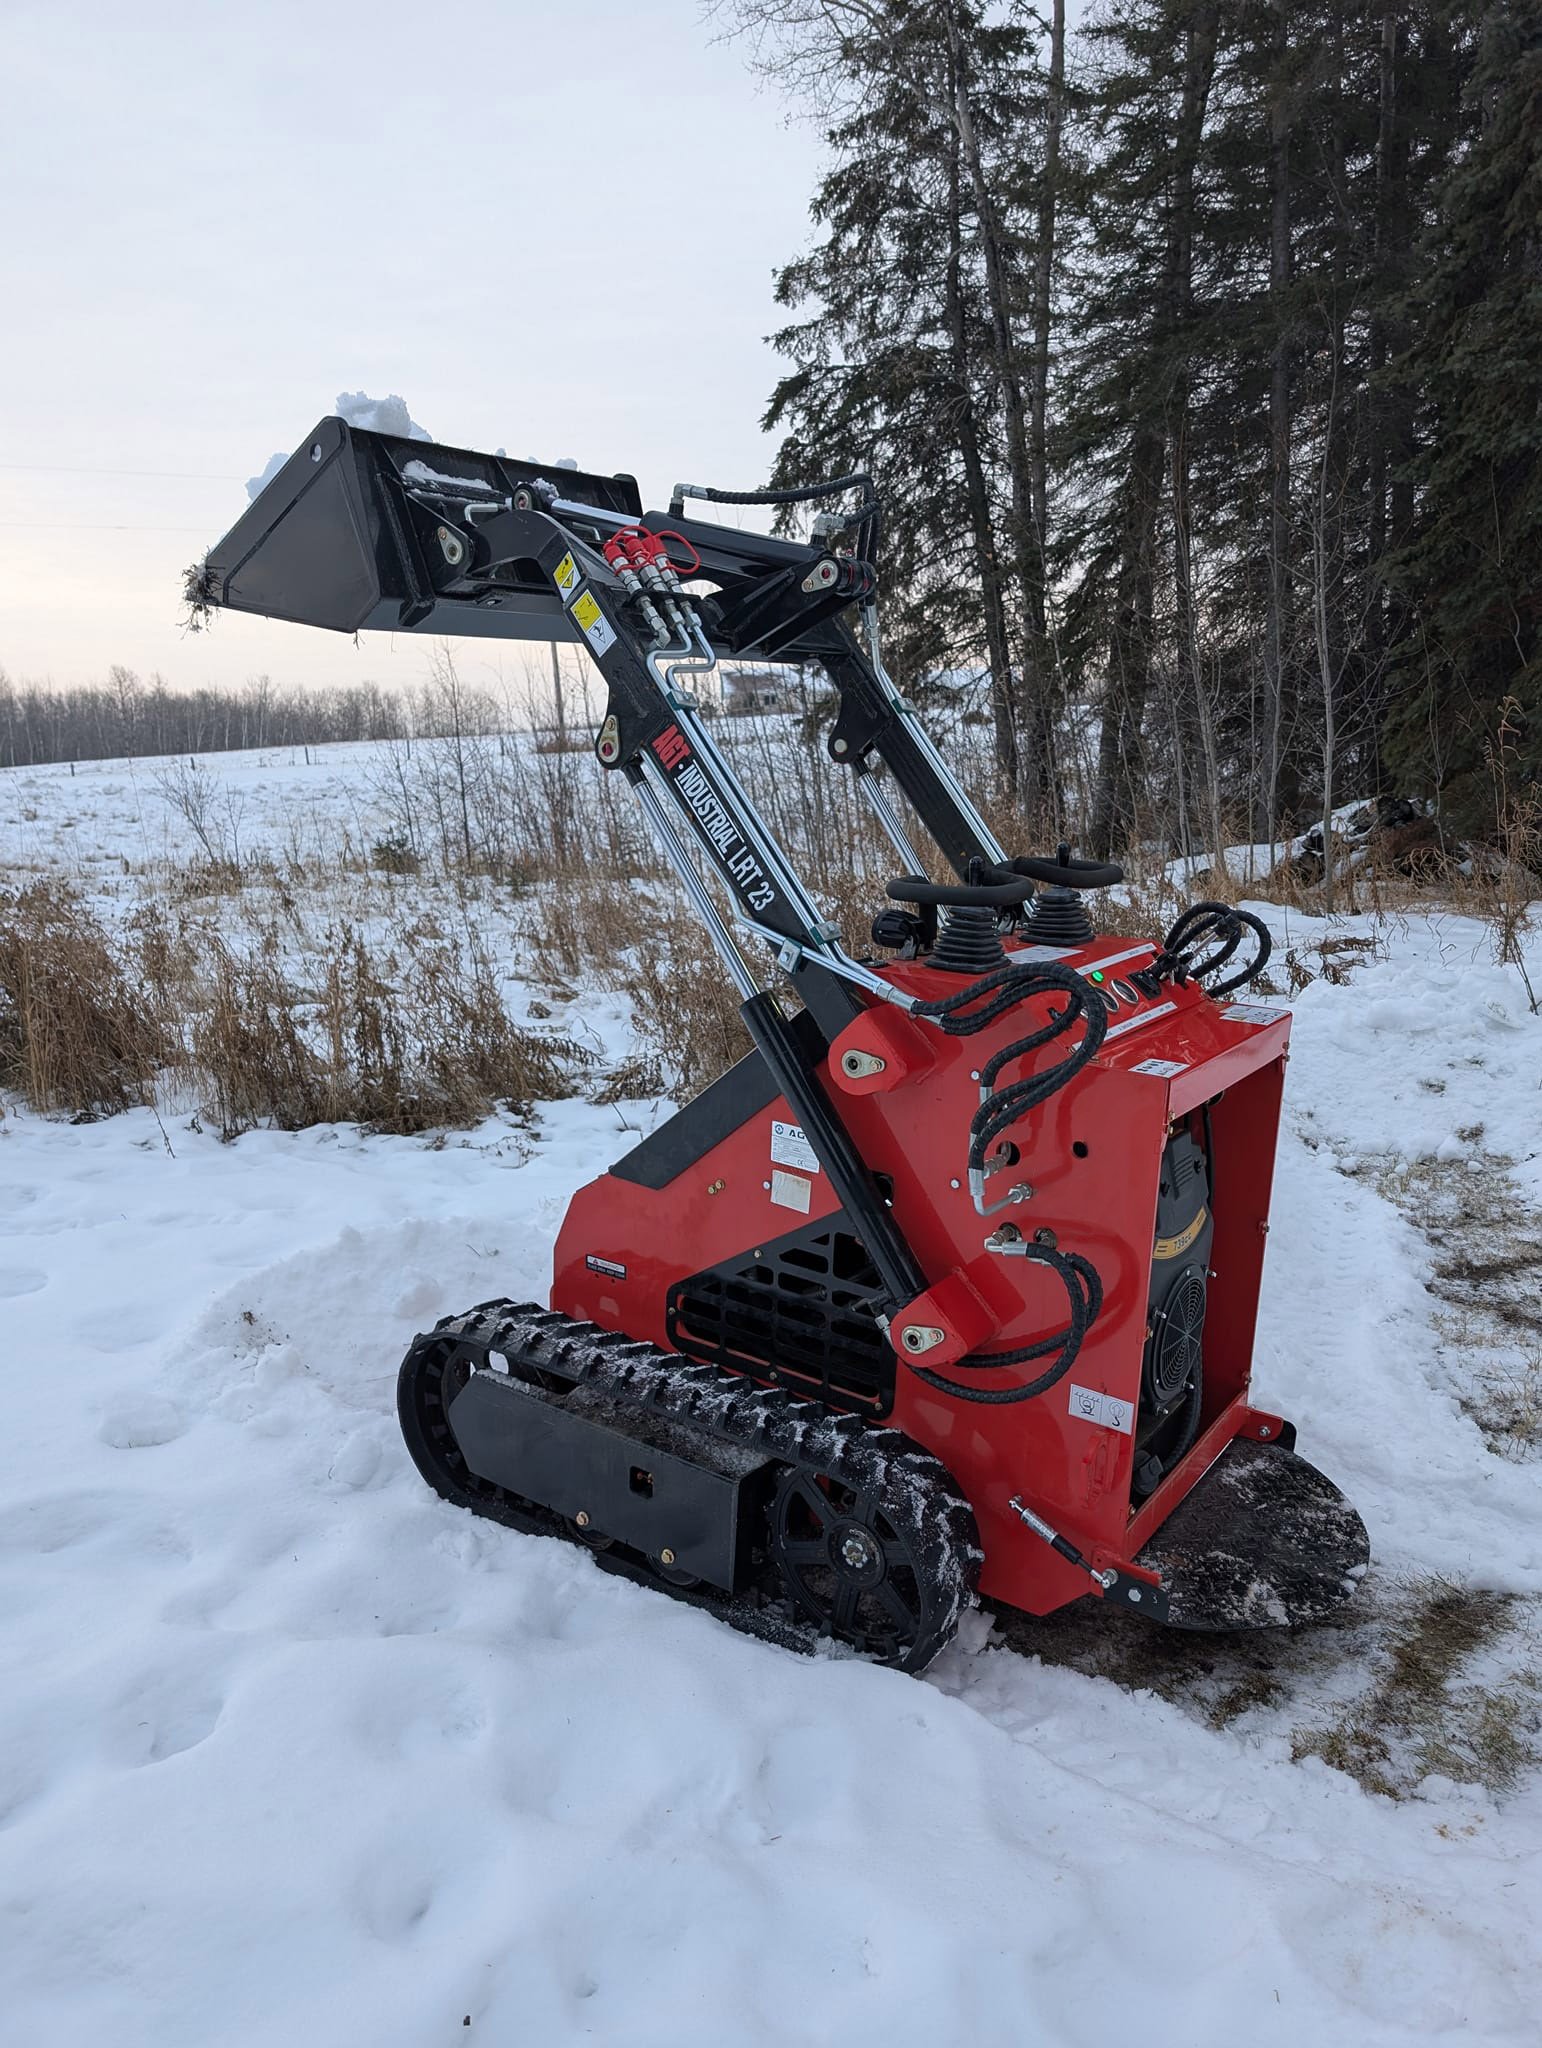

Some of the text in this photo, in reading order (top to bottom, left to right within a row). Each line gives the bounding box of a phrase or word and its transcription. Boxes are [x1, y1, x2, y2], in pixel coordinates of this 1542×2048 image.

[652, 724, 775, 911] AGT INDUSTRIAL LRT 23
[789, 1129, 806, 1139] AG
